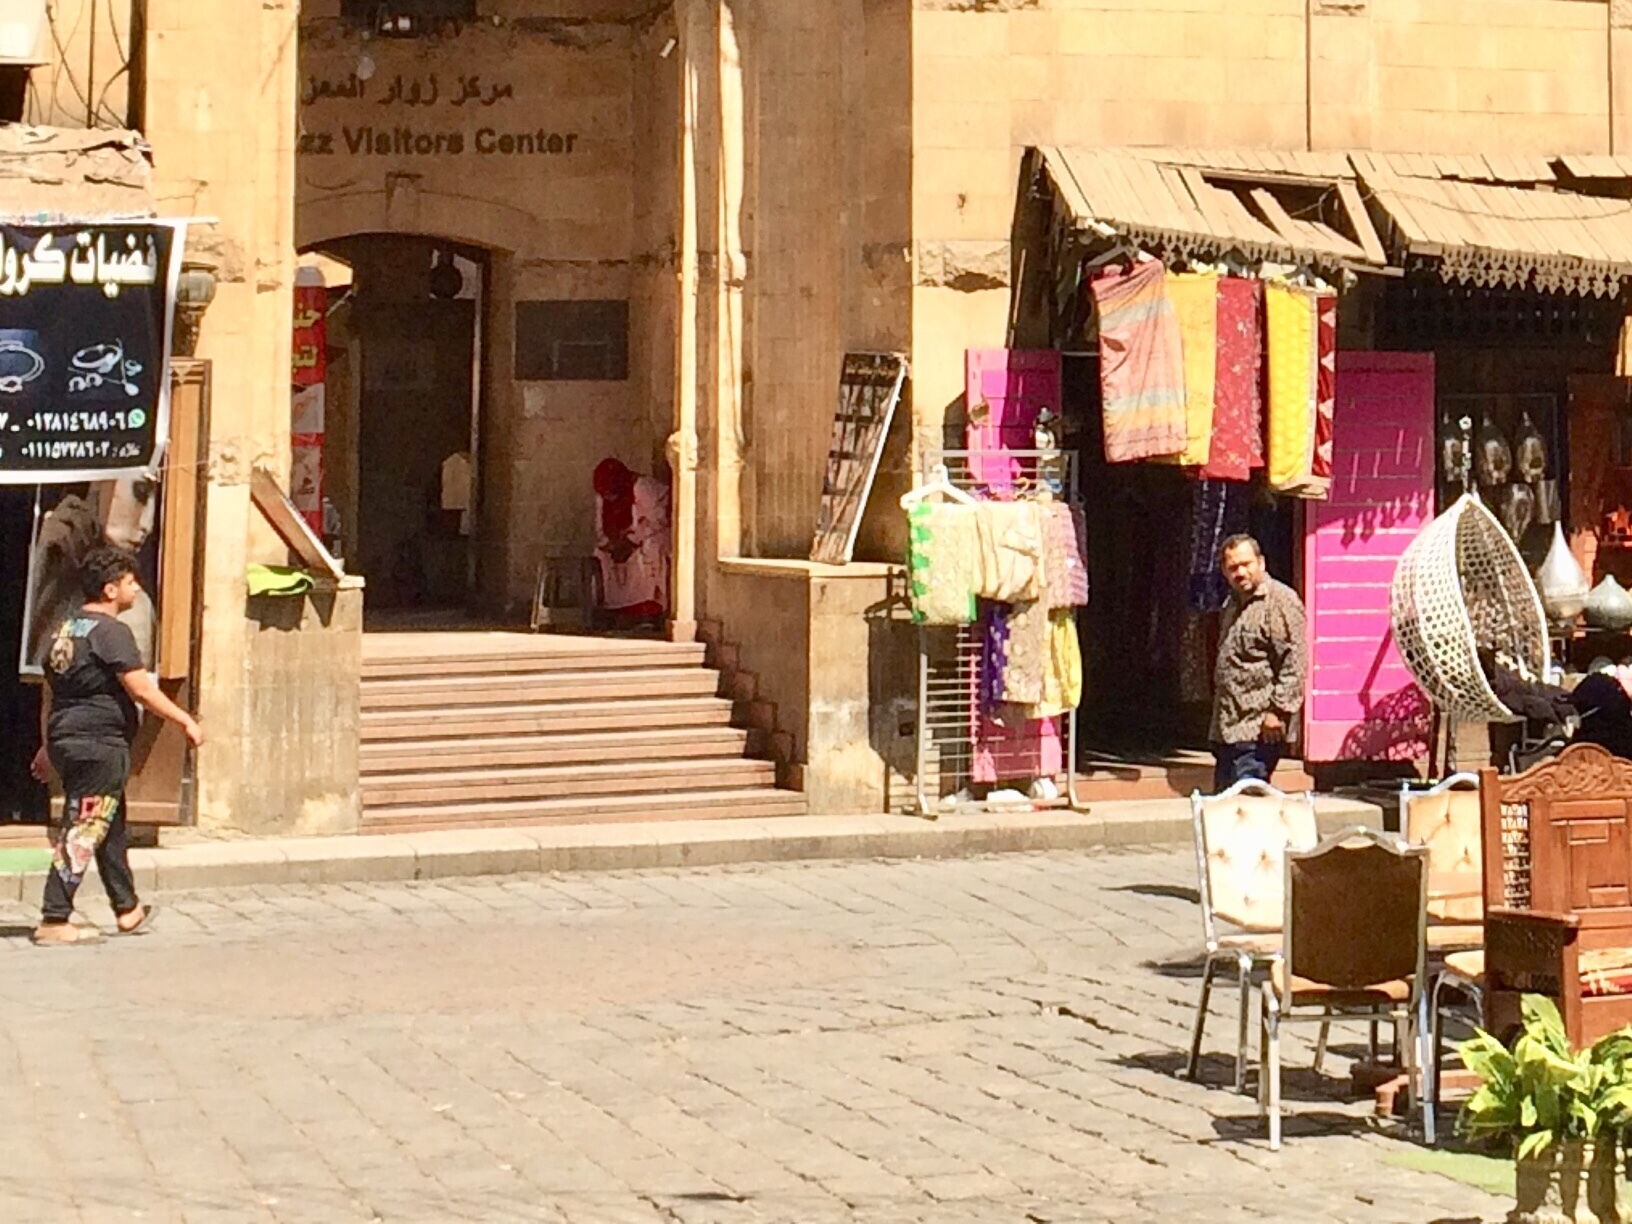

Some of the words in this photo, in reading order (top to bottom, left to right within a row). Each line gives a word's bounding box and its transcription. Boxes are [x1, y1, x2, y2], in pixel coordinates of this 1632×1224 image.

[377, 73, 439, 107] زوار
[451, 75, 514, 107] مركز
[342, 126, 465, 157] Visitors
[474, 126, 580, 156] Center
[70, 231, 158, 300] فضيات
